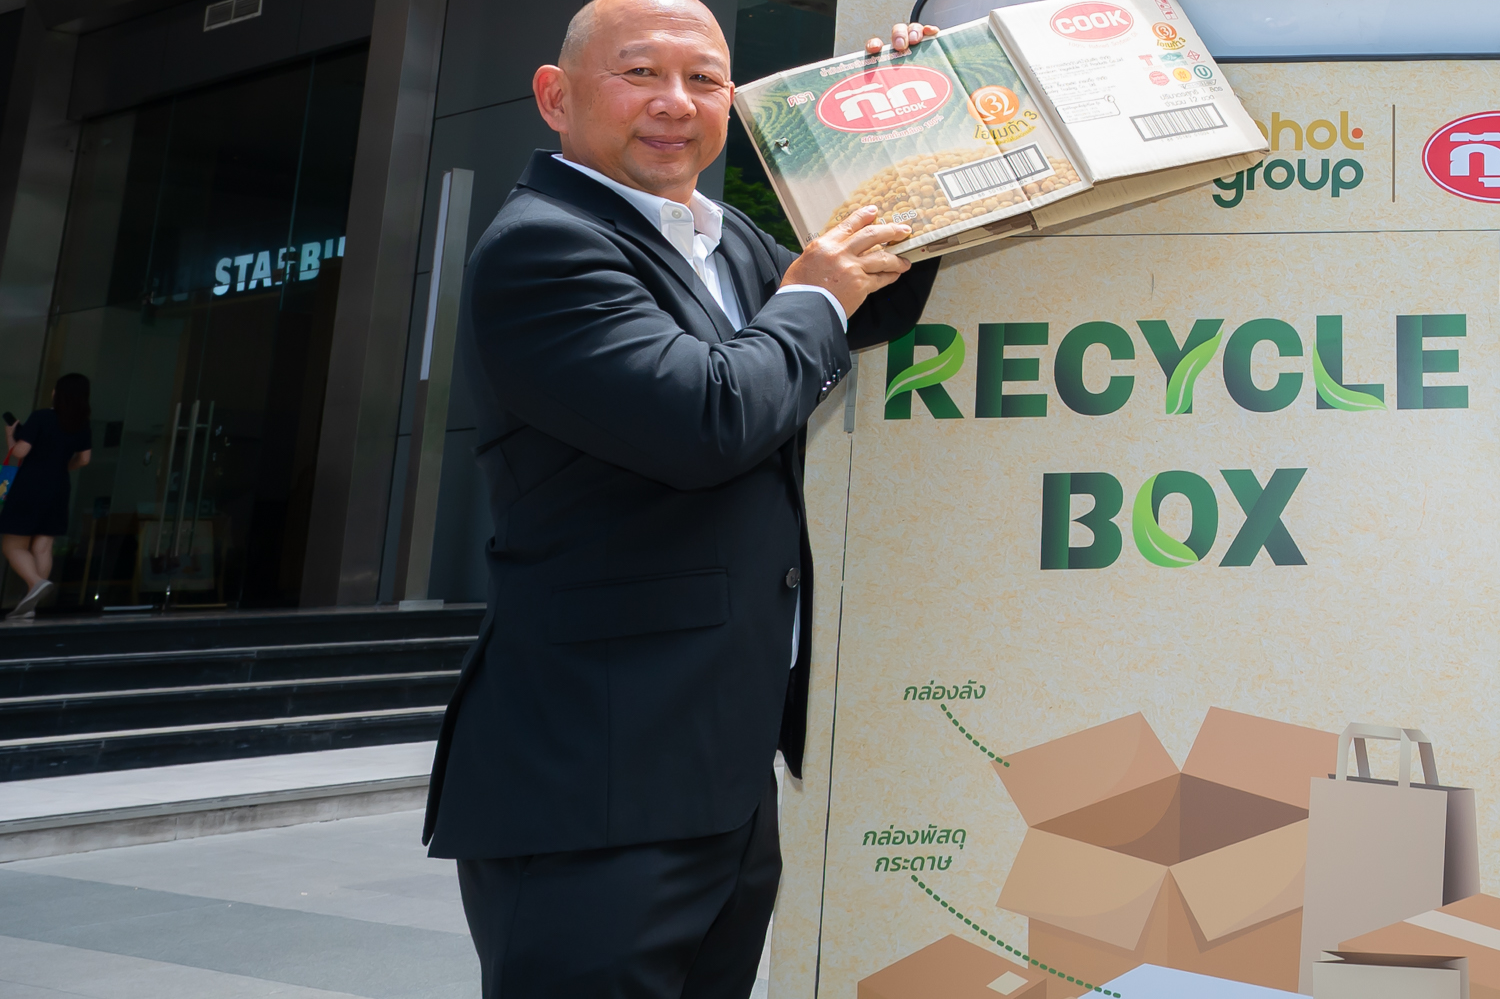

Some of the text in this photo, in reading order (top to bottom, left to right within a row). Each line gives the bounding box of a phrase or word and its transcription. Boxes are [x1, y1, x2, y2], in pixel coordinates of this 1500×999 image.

[1055, 9, 1130, 34] COOK
[787, 91, 816, 108] ตรา
[895, 101, 927, 117] COOK
[1024, 110, 1037, 121] 3
[1254, 111, 1364, 151] hol
[1212, 158, 1364, 208] group
[884, 314, 1470, 421] RECYCLE
[1040, 467, 1309, 570] BOX
[903, 679, 986, 701] กล่องลัง
[862, 824, 966, 850] กล่องพัสดุ
[875, 854, 953, 873] กระดาษ
